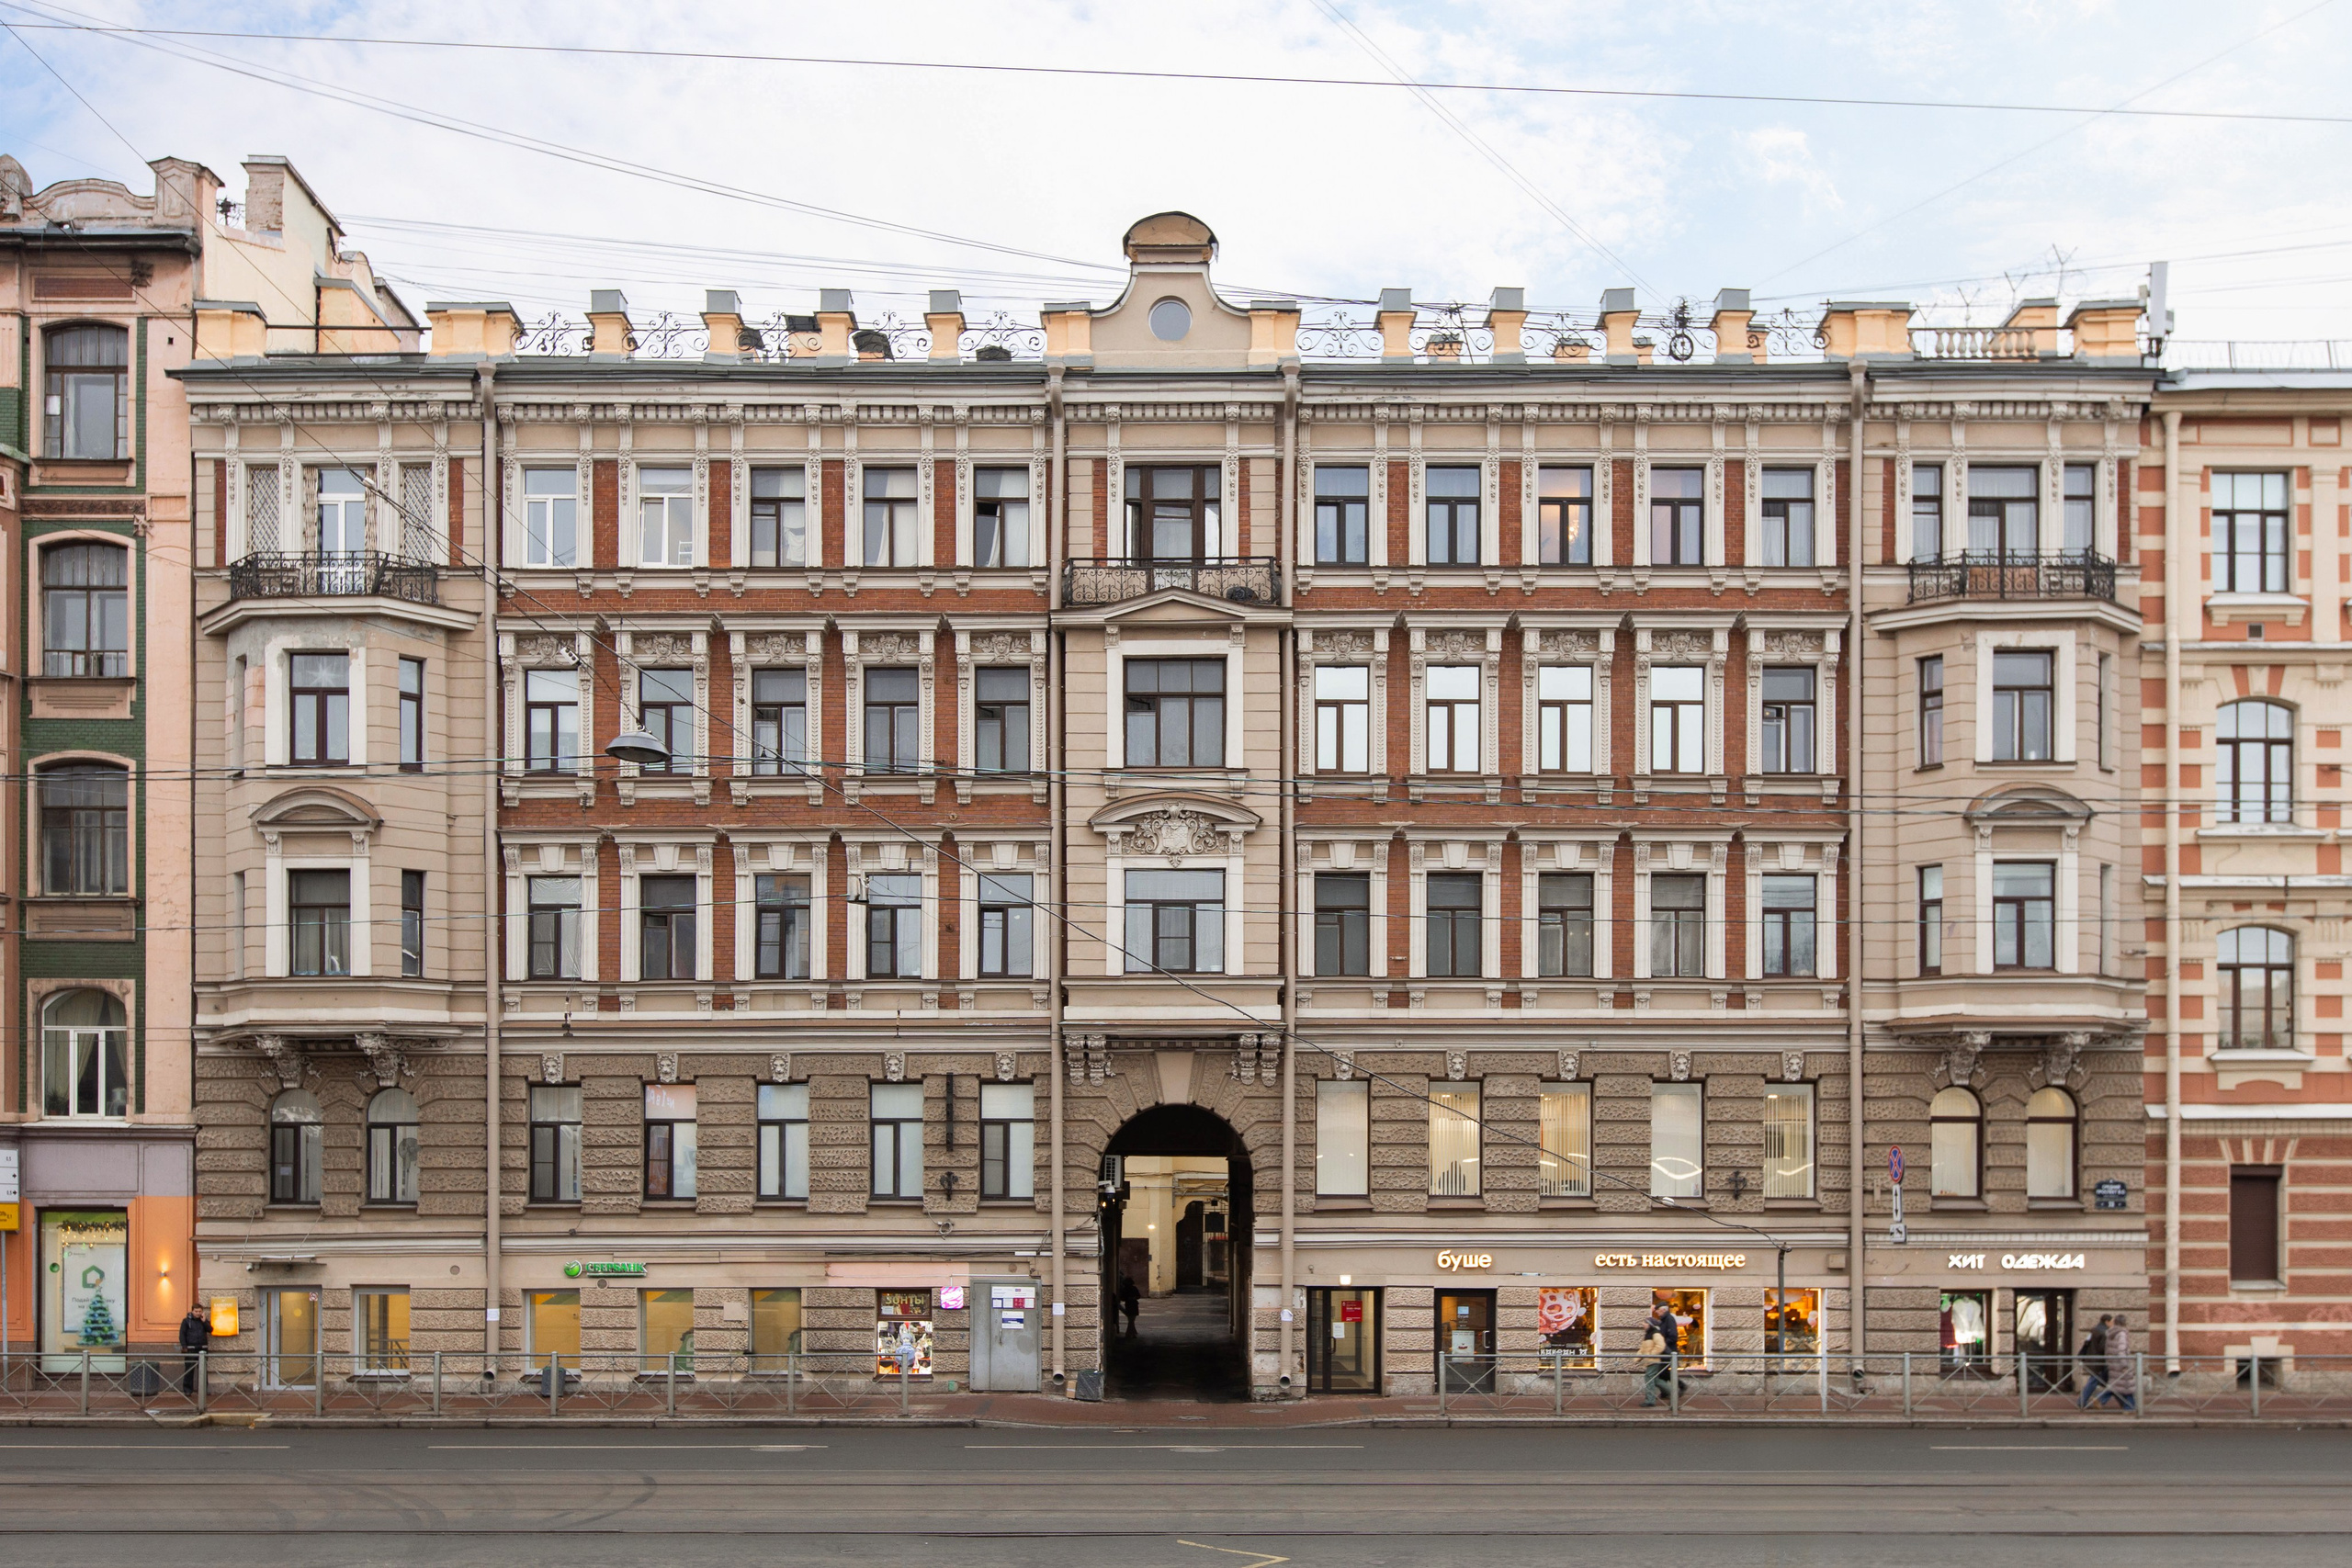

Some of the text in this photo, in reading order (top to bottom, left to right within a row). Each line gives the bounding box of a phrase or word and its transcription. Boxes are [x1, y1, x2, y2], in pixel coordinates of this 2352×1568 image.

[585, 1262, 648, 1274] СБЕРБАНК
[1437, 1249, 1492, 1272] буше
[1594, 1254, 1746, 1270] есть настоящее
[1948, 1254, 2086, 1269] ХИТ ОДЕЖДА
[885, 1295, 924, 1304] ЗОНТЫ
